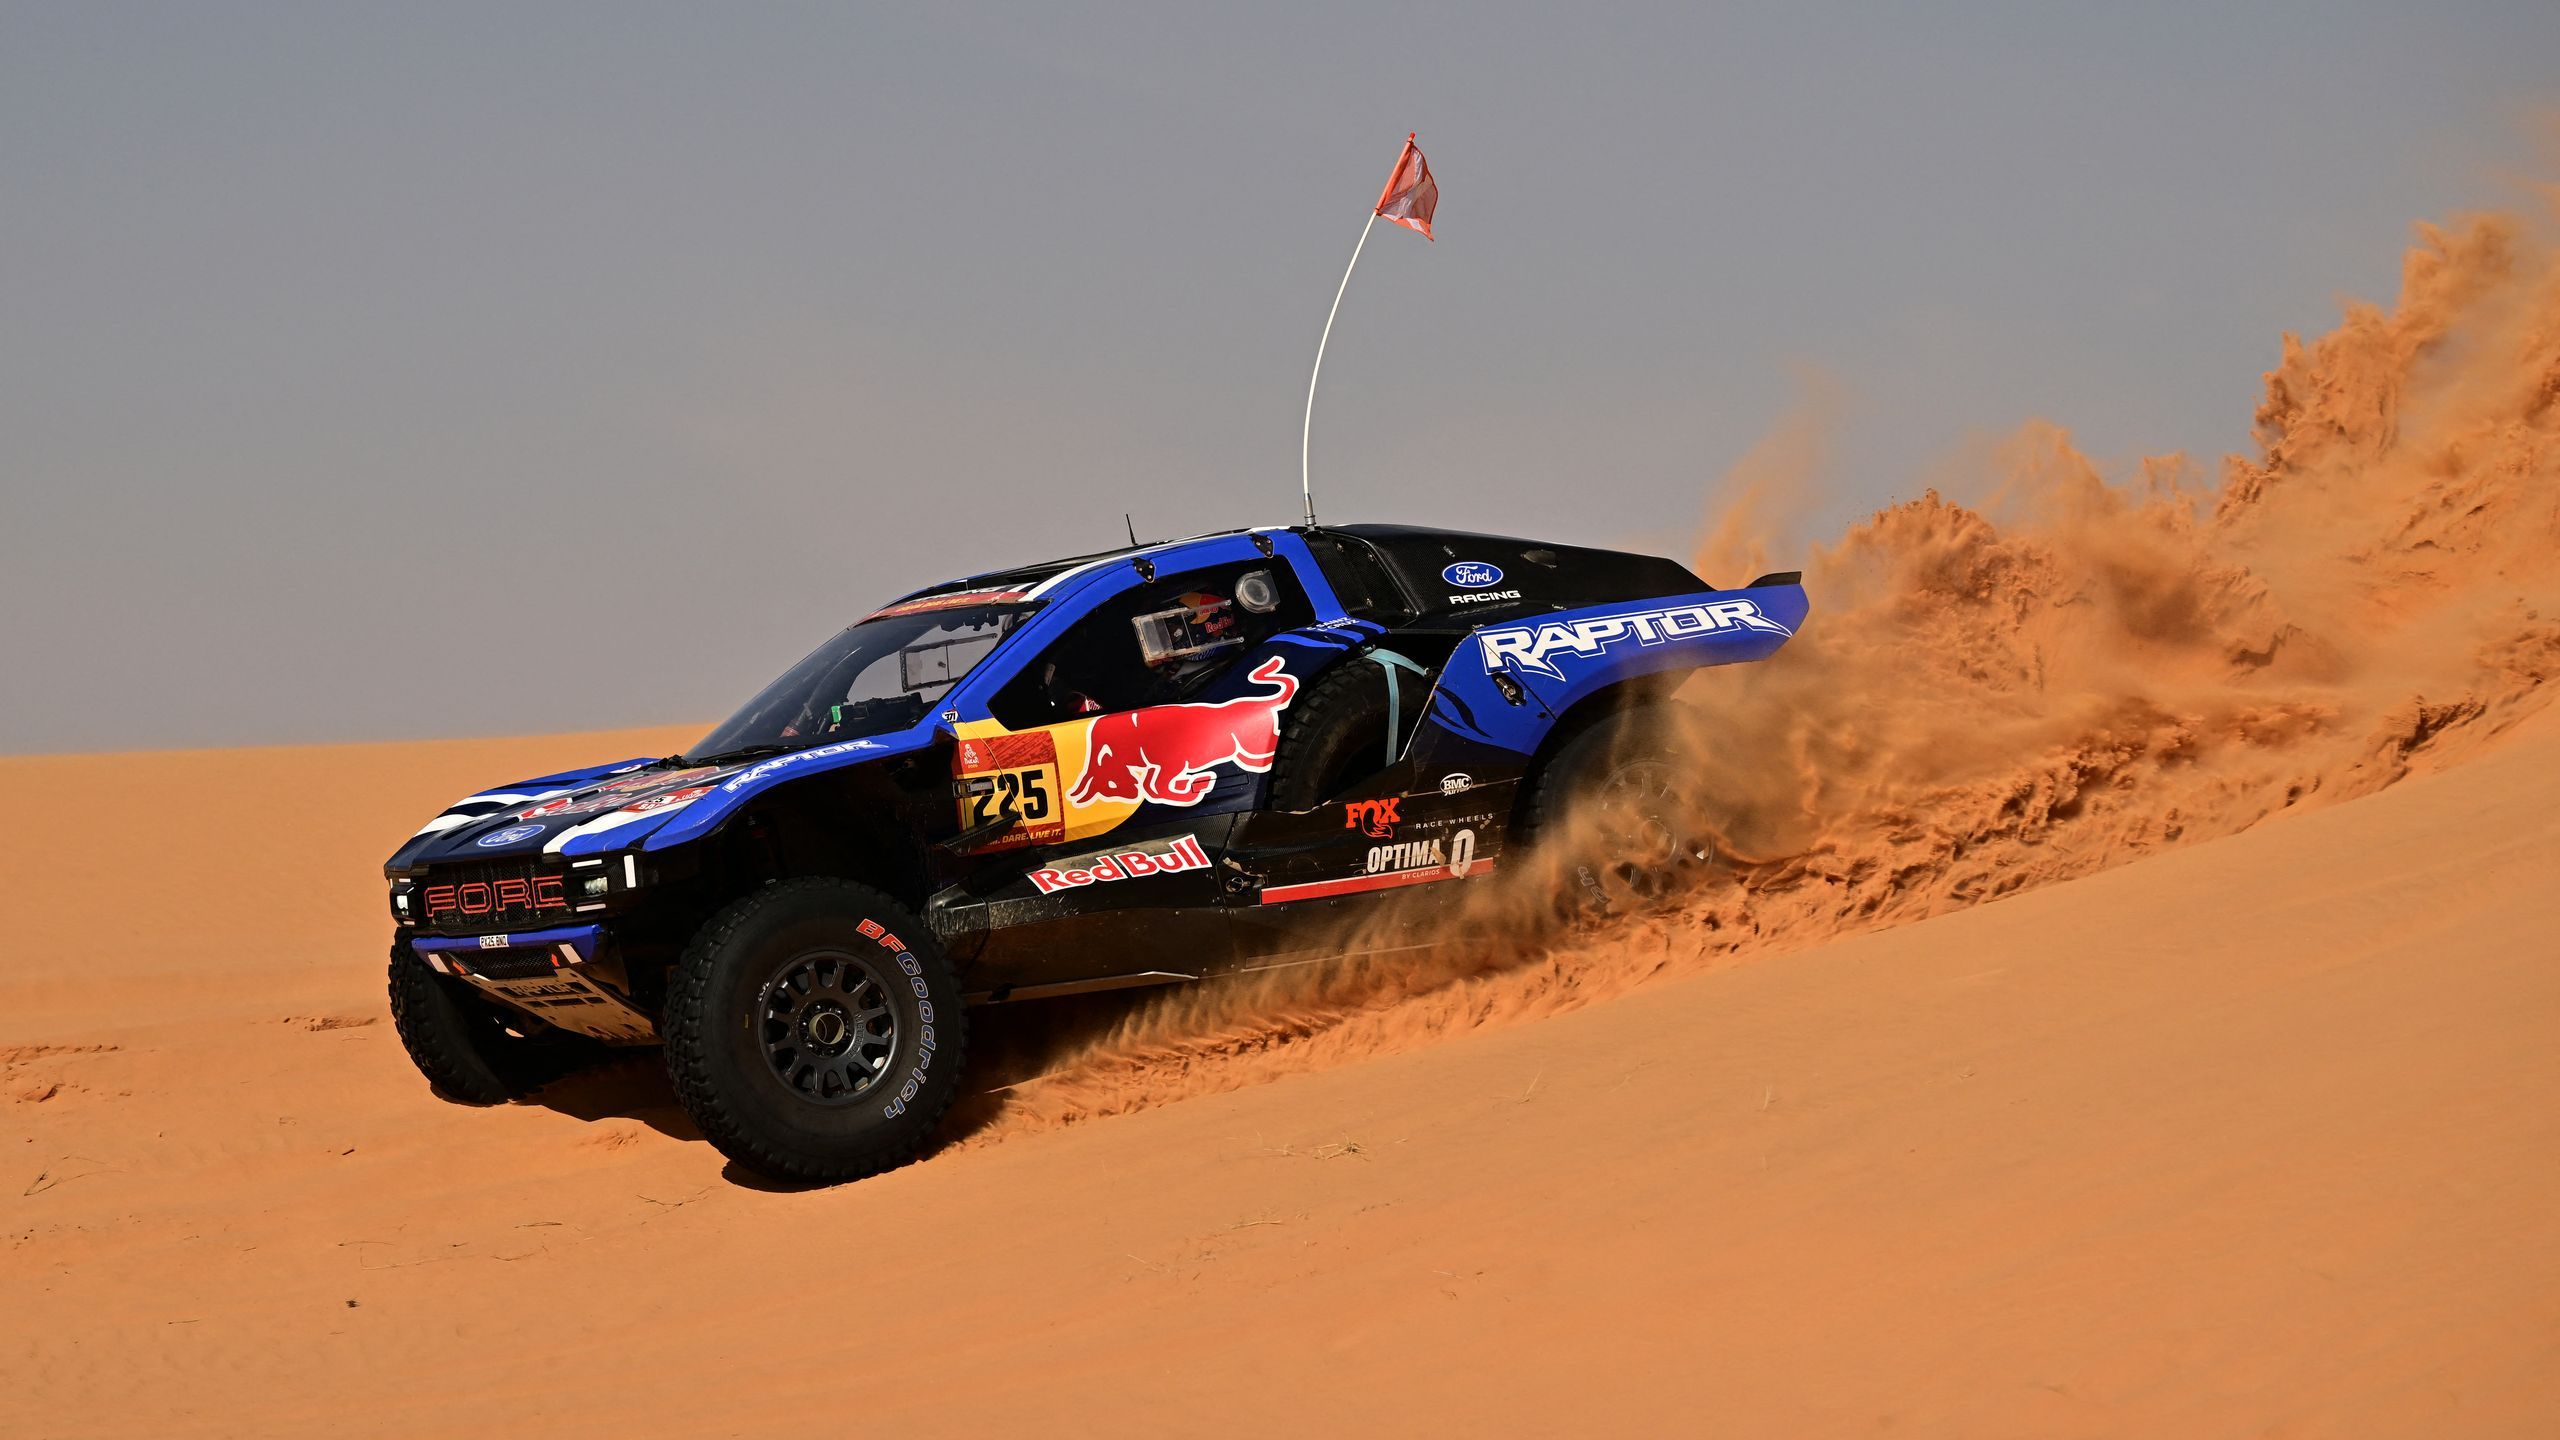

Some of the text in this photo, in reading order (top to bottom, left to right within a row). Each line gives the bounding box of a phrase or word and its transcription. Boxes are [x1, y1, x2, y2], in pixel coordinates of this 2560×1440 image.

[1455, 565, 1493, 584] Ford
[1448, 590, 1522, 605] RACING
[1480, 599, 1792, 682] RAPTOR
[722, 740, 889, 793] RAPTOR
[970, 769, 1049, 826] 225
[1443, 778, 1470, 791] BMC
[1345, 797, 1401, 837] FOX
[1415, 813, 1494, 830] RACE WHEELS
[1002, 833, 1029, 844] DARE.
[1030, 830, 1050, 840] LIVE
[1051, 829, 1062, 837] IT.
[1027, 835, 1211, 893] Red Bull
[1367, 839, 1442, 873] OPTIMA
[1412, 869, 1440, 879] CLARIOS
[855, 918, 936, 1119] BFGoodrich
